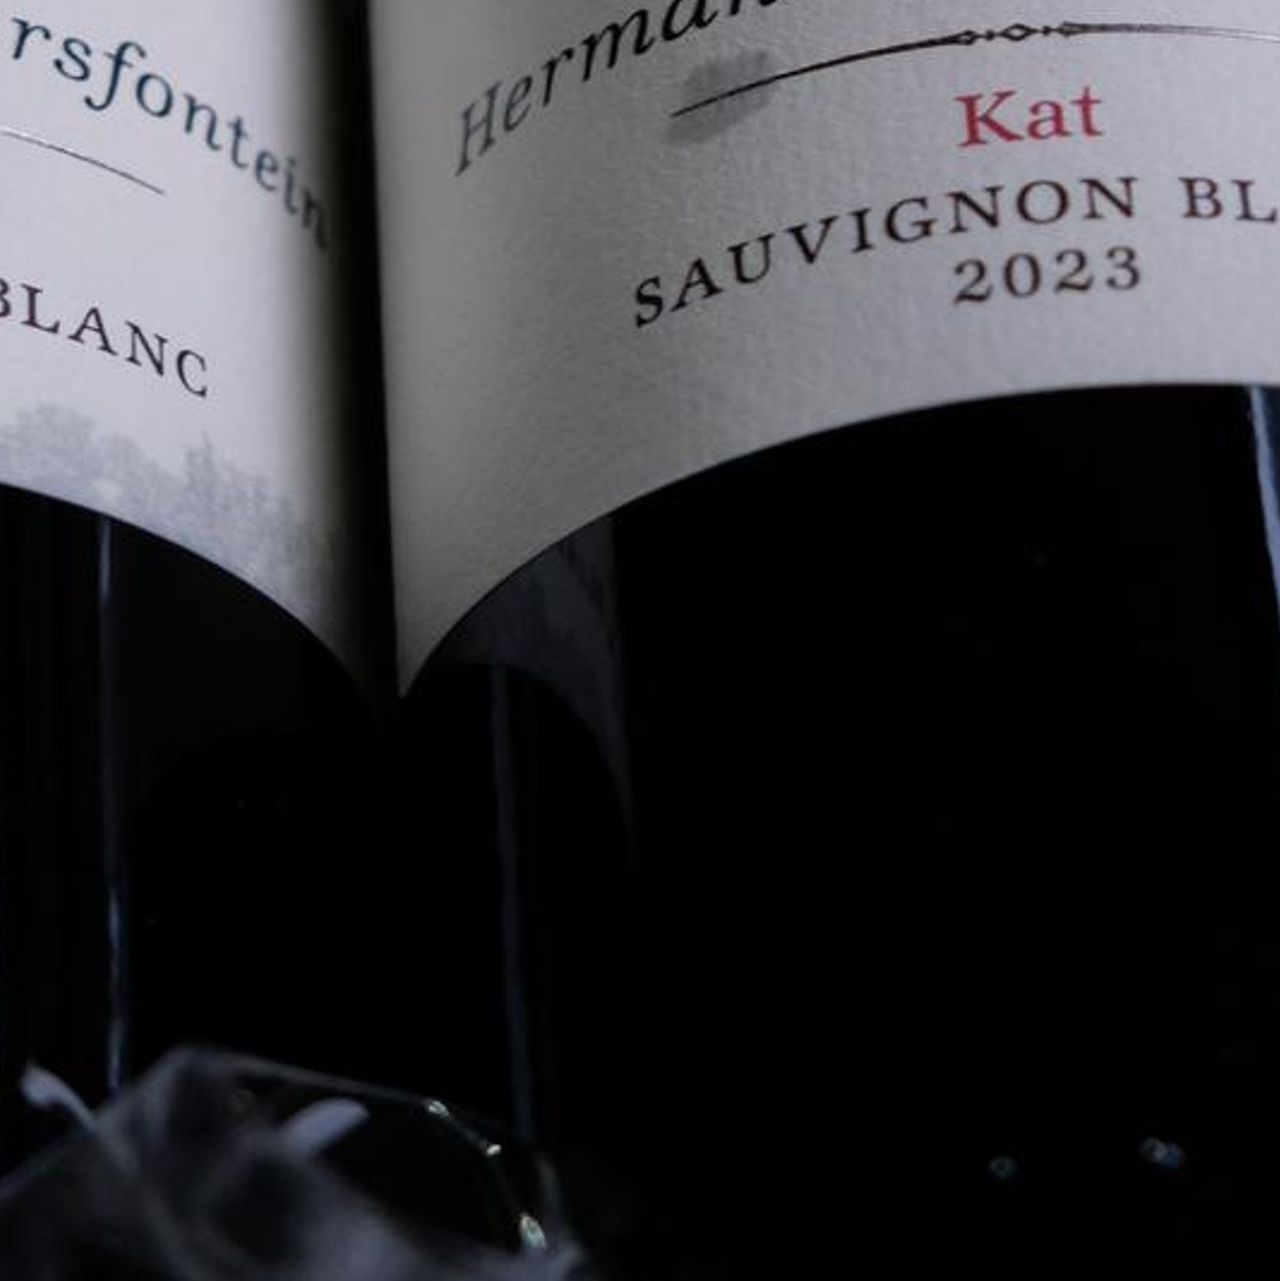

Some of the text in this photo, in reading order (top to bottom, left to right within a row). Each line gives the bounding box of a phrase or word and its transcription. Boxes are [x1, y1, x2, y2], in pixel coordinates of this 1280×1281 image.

[955, 85, 1105, 149] Kat
[632, 175, 1139, 329] SAUVIGNON
[951, 245, 1143, 307] 2023
